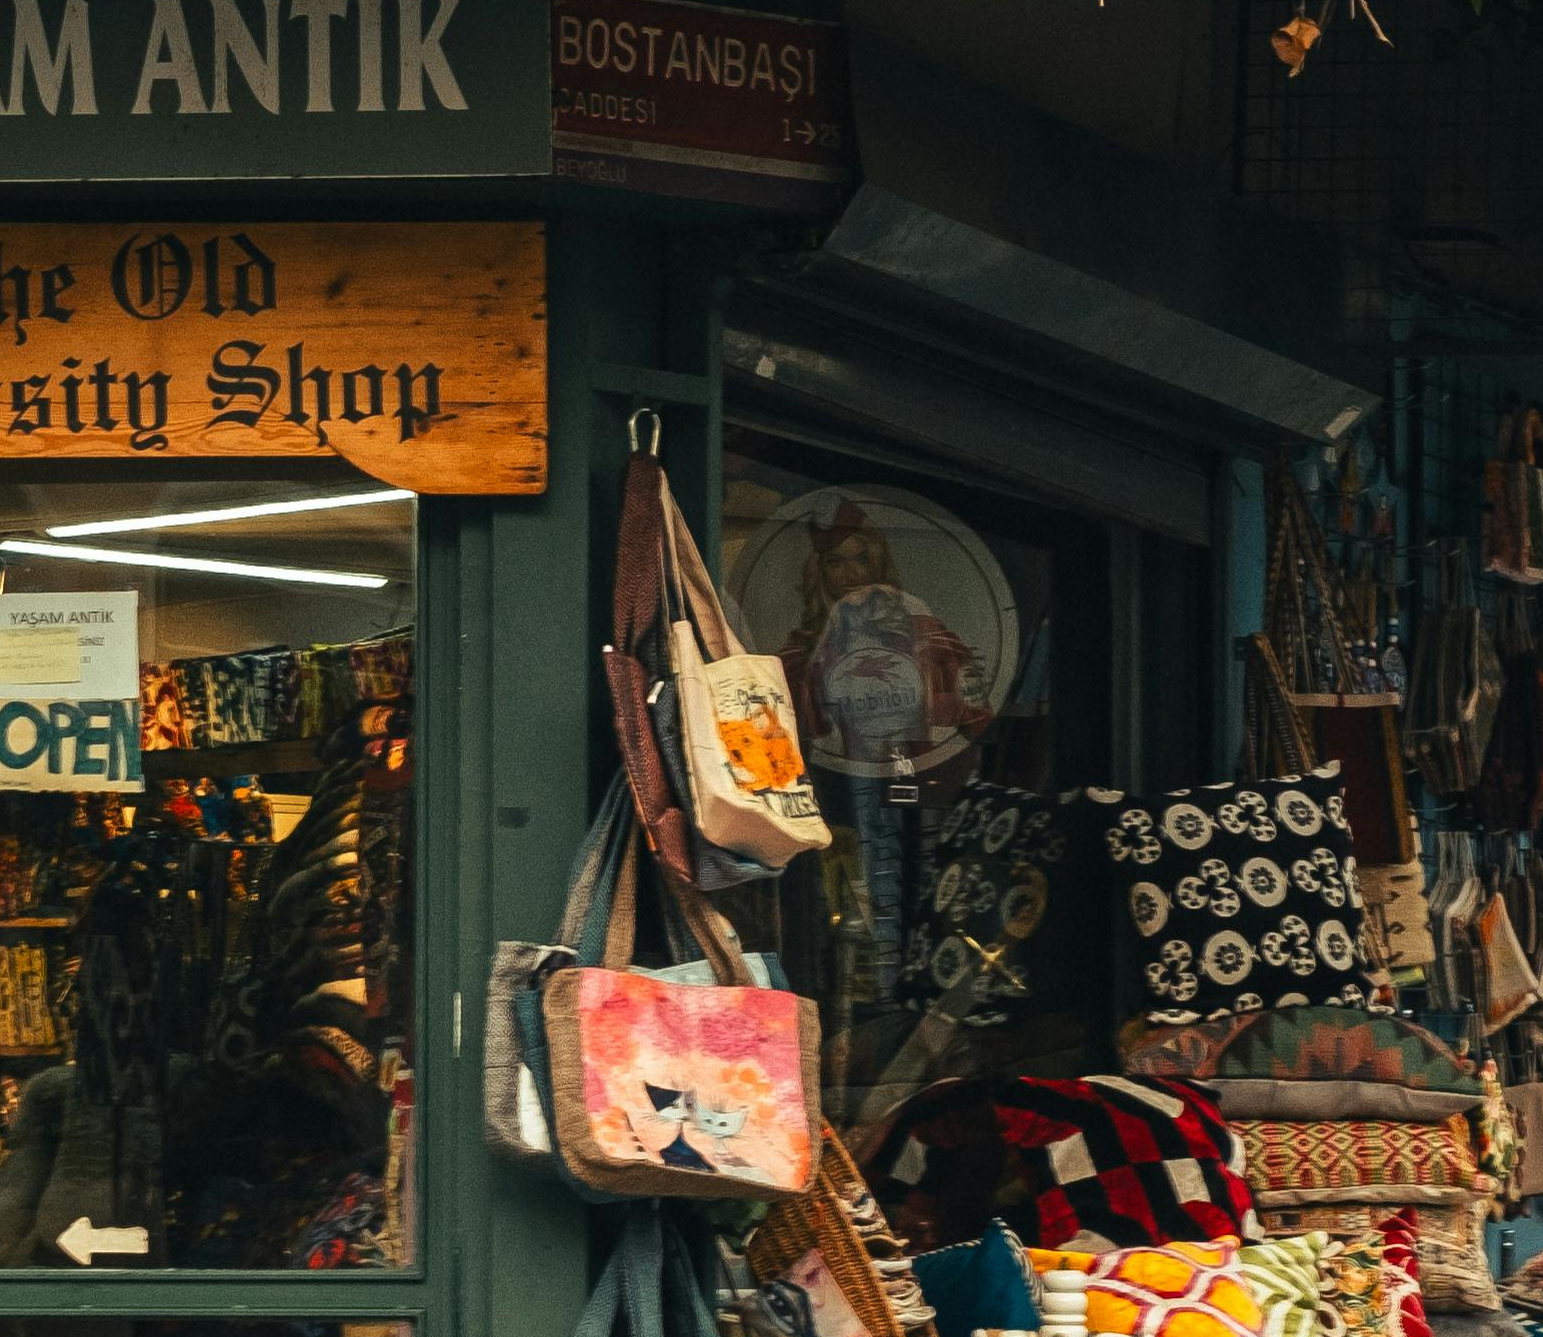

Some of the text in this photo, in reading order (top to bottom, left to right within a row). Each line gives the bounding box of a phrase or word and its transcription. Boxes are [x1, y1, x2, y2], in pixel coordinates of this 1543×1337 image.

[559, 14, 816, 103] BOSTANBAŞI
[110, 232, 278, 321] Old
[205, 338, 459, 448] Shop
[9, 610, 64, 628] YAŞAM
